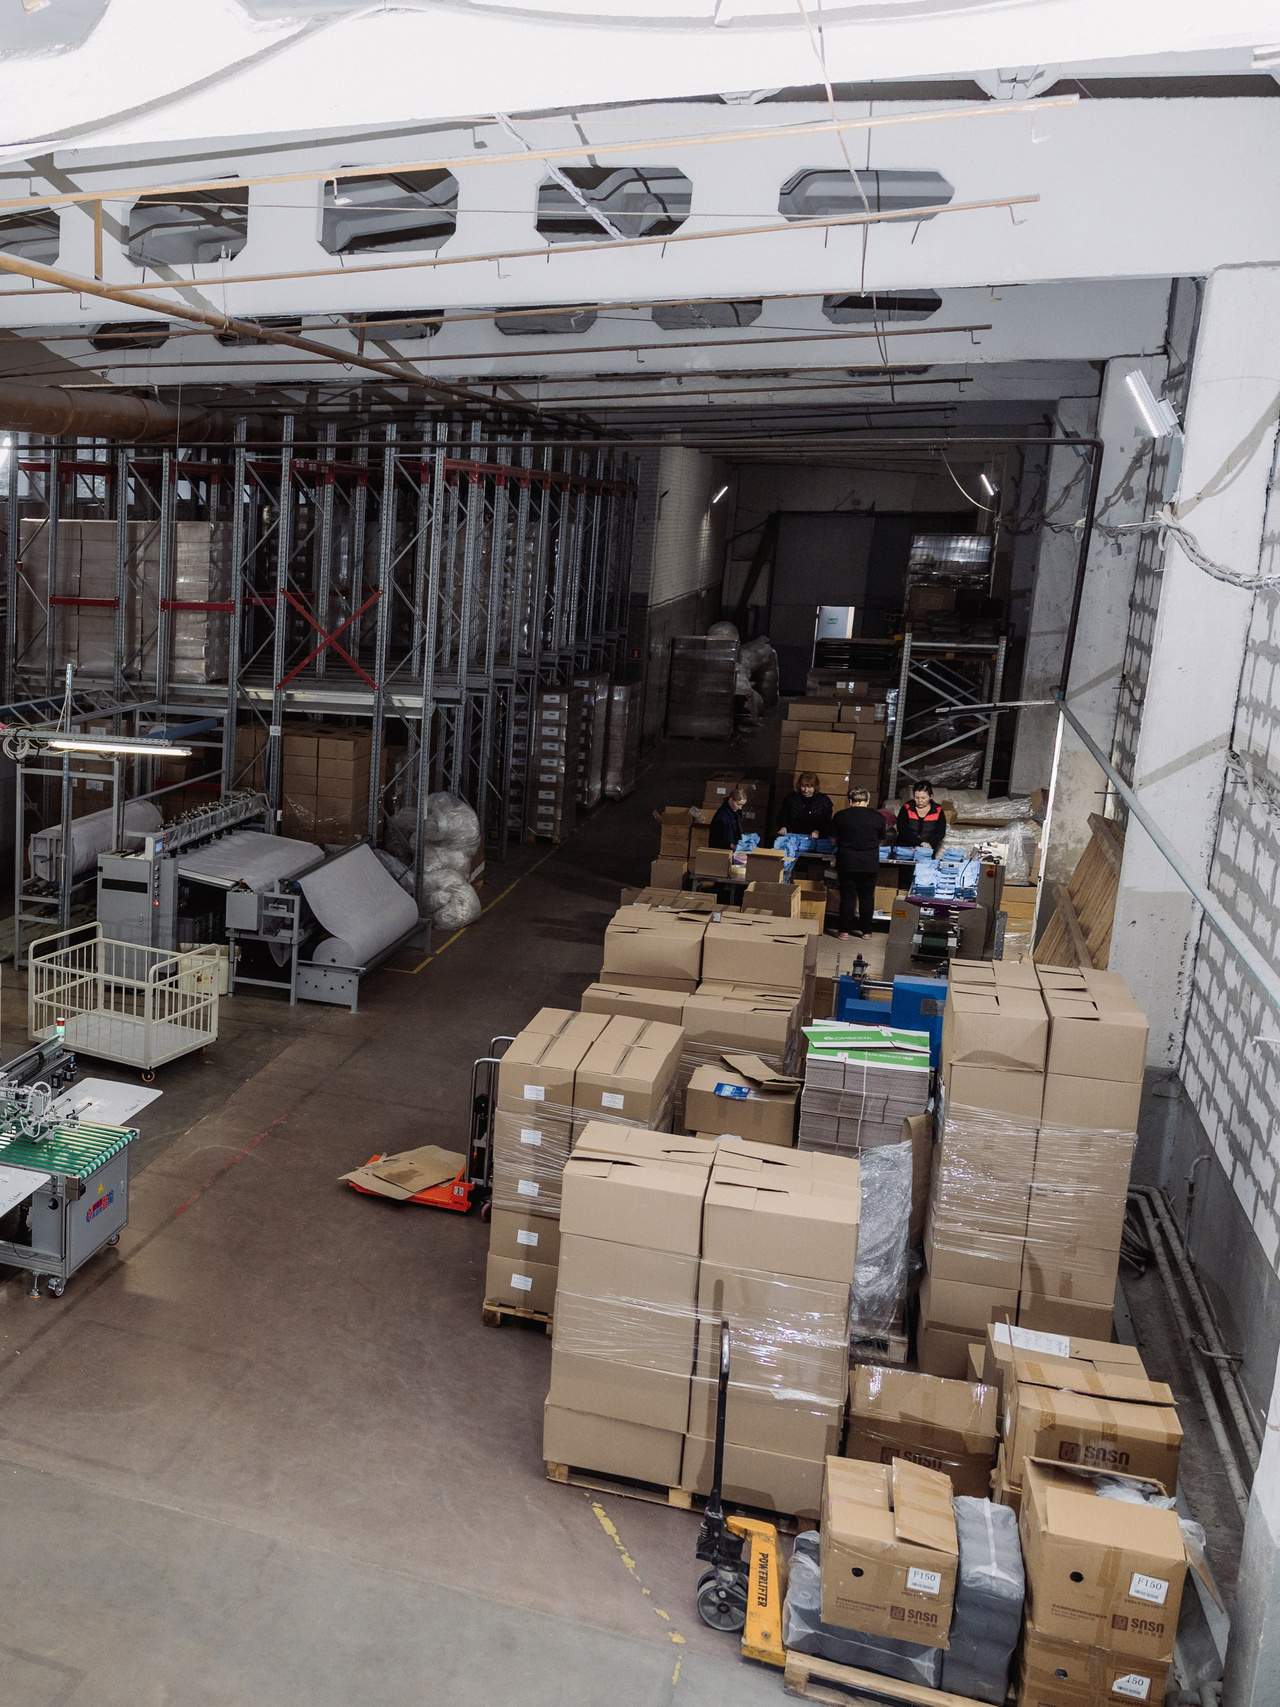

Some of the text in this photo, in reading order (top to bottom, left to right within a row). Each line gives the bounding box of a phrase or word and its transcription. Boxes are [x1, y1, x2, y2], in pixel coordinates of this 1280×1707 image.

[757, 1552, 769, 1607] POWERLIFTER
[913, 1570, 936, 1582] F150
[1137, 1576, 1163, 1590] F150
